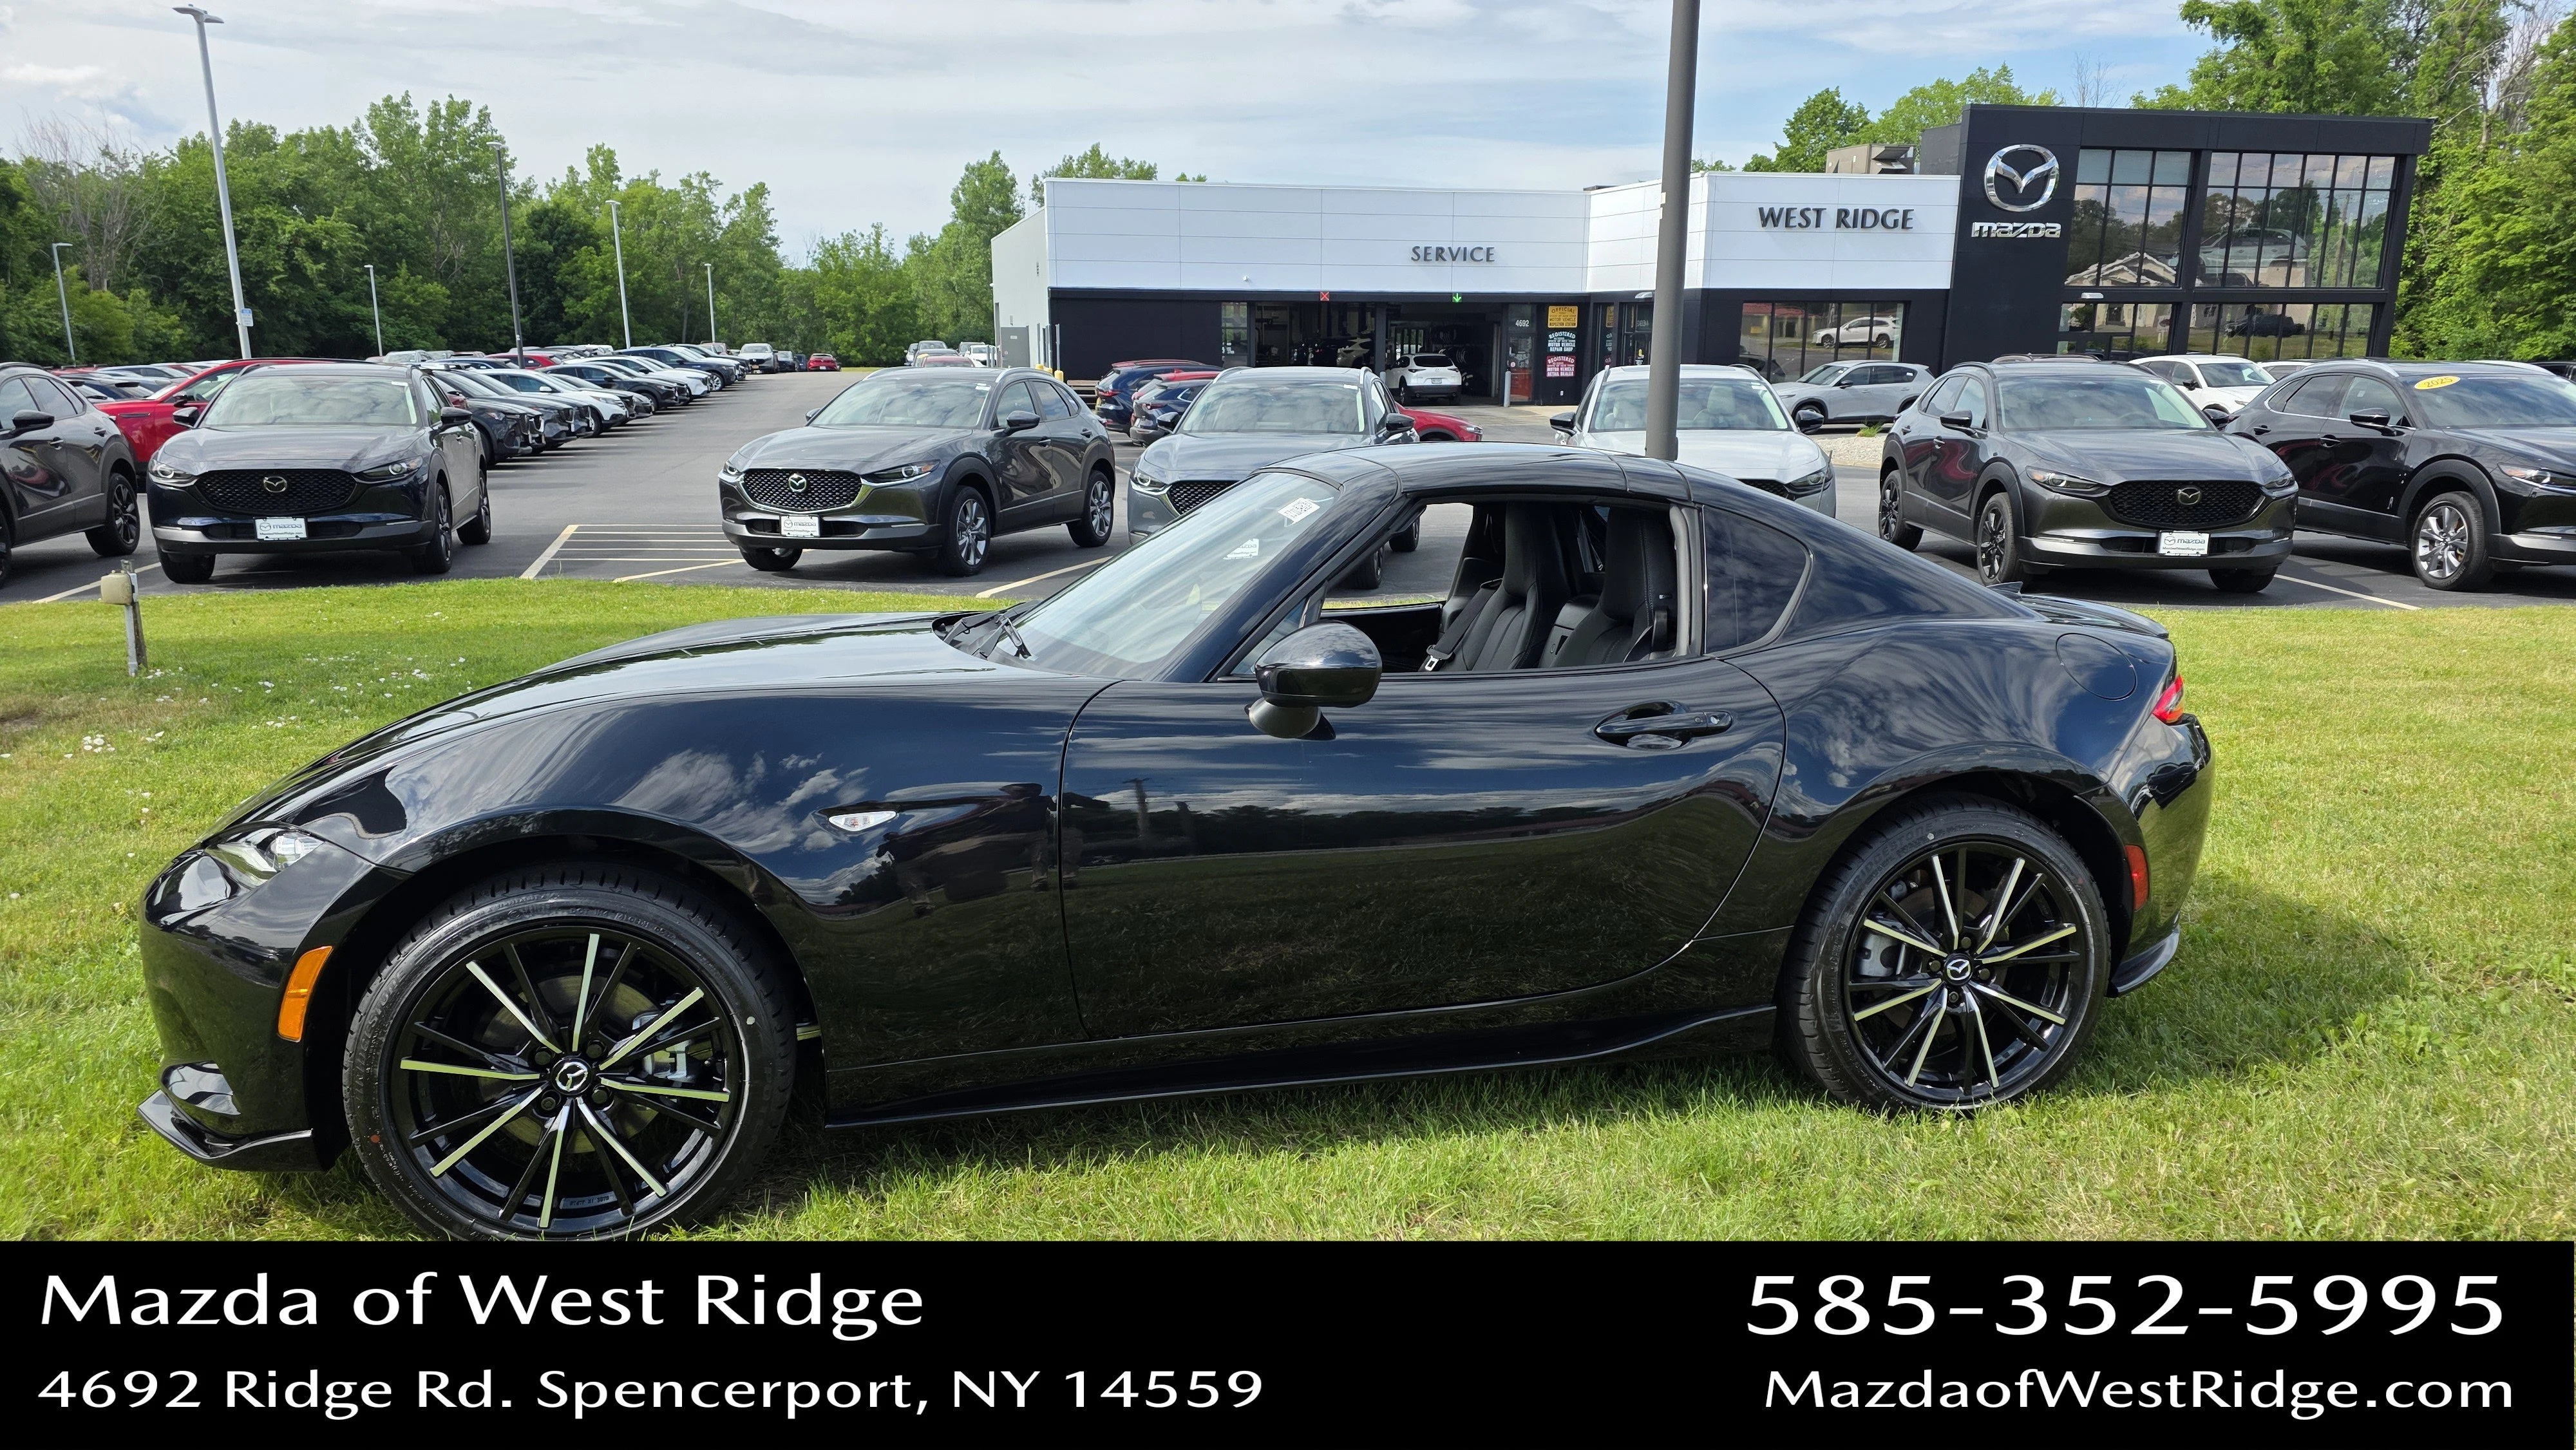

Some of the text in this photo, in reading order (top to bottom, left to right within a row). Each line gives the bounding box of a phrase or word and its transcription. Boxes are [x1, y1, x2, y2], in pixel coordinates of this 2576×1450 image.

[1758, 207, 1915, 229] WEST RIDGE
[1971, 222, 2061, 238] mazda
[1411, 245, 1495, 262] SERVICE
[1548, 331, 1576, 339] REGISTERED
[2424, 377, 2453, 388] 2025
